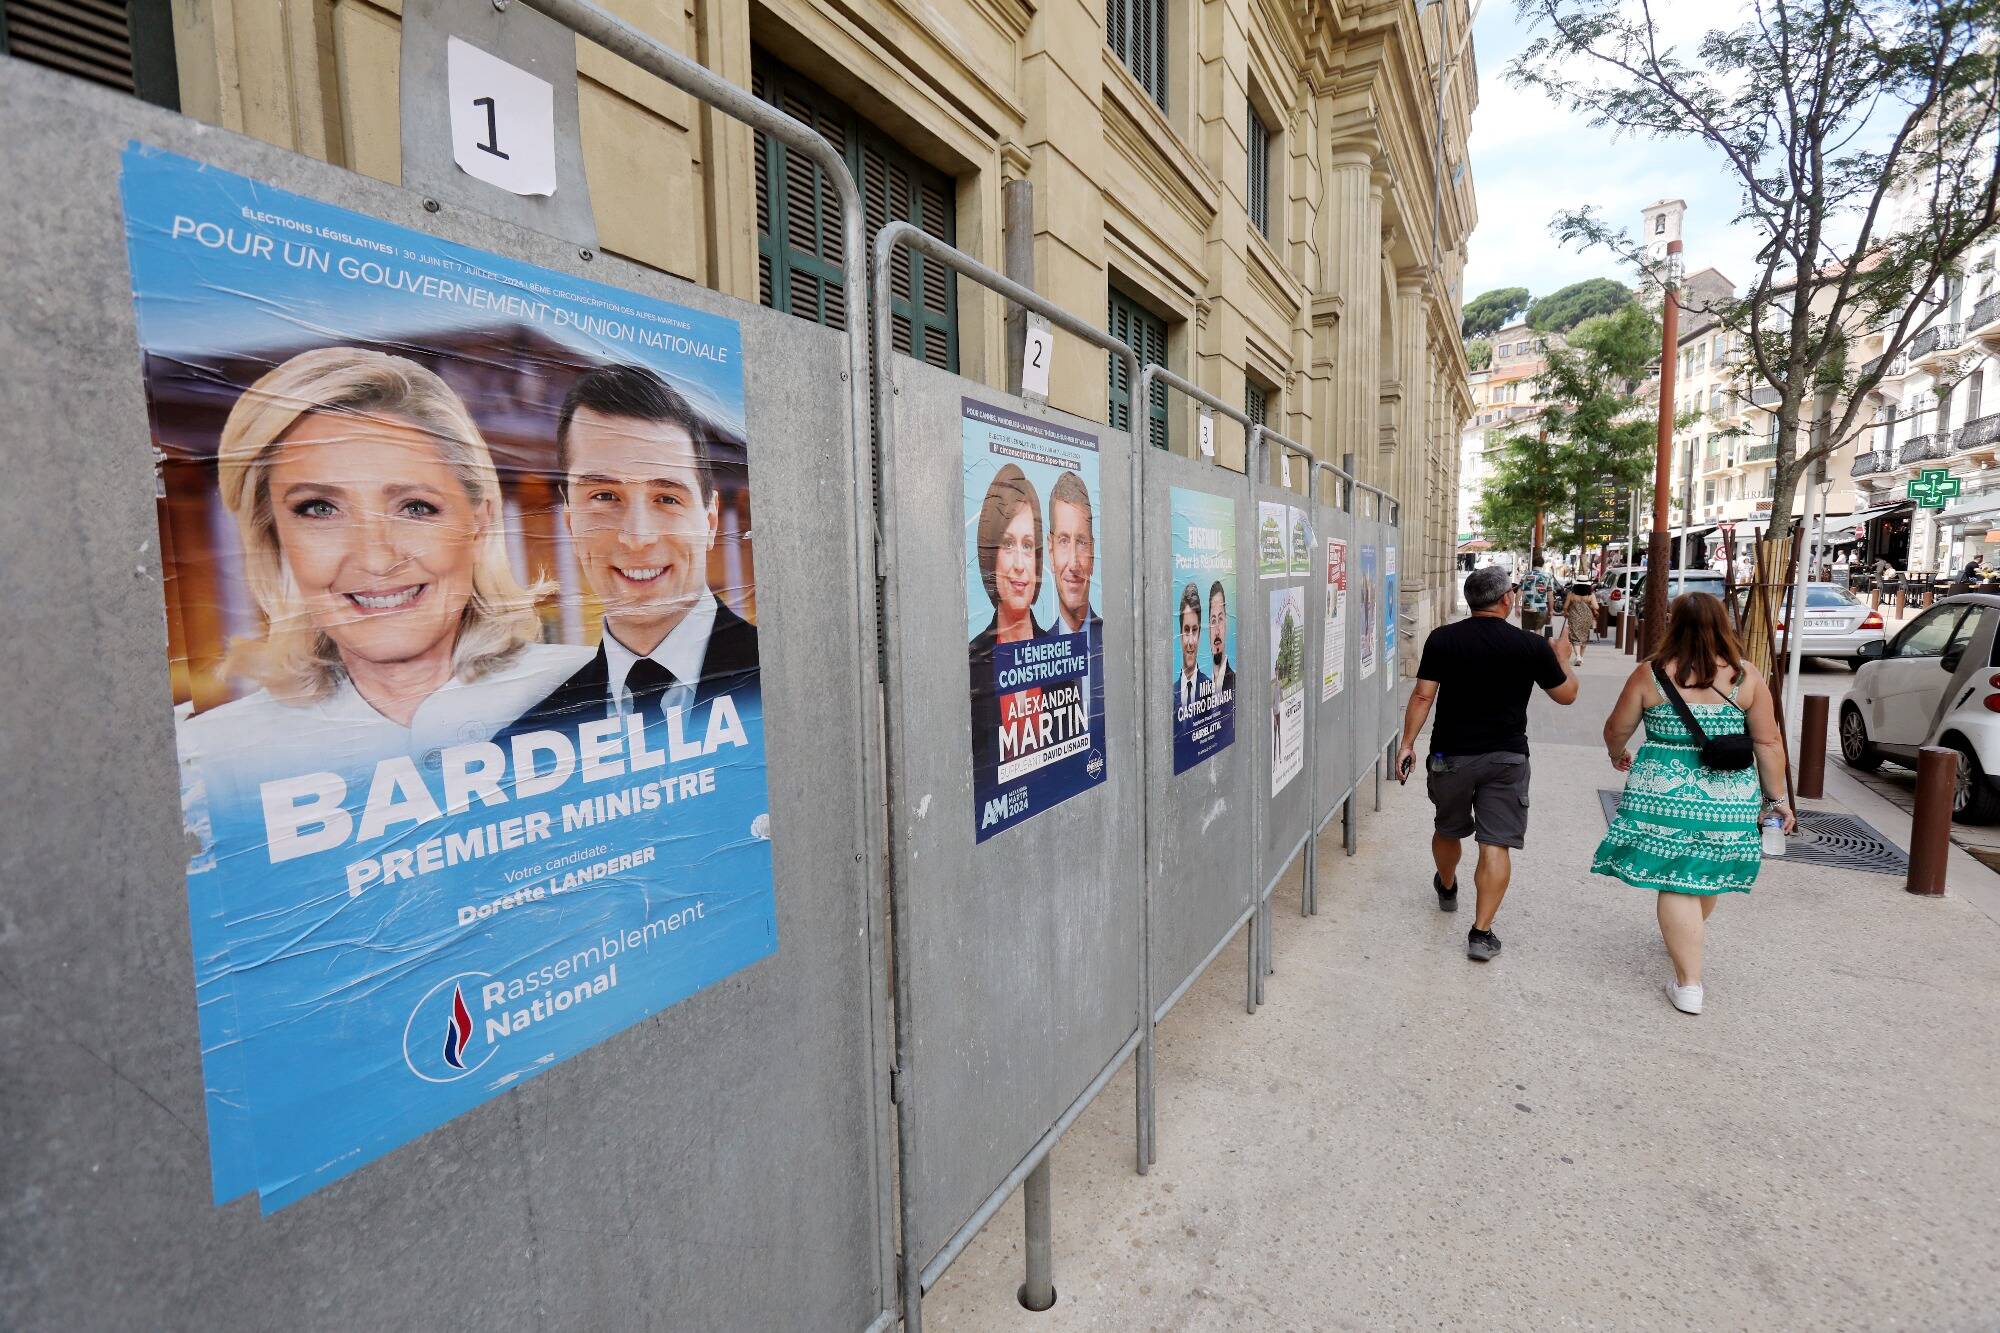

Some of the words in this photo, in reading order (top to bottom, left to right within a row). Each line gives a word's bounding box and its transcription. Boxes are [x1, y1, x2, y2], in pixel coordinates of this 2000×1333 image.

[473, 96, 510, 161] 1
[241, 206, 313, 234] ÉLECTIONS
[315, 226, 393, 255] LÉGISLATIVES
[402, 249, 416, 261] 30
[418, 254, 441, 268] JUIN
[442, 259, 455, 272] ET
[456, 262, 462, 273] 7
[552, 289, 621, 313] CIRCONSCRIPTION
[620, 305, 635, 316] DES
[171, 215, 274, 261] POUR
[283, 241, 330, 273] UN
[338, 256, 551, 321] GOUVERNEMENT
[553, 307, 635, 343] D'UNION
[638, 327, 728, 363] NATIONALE
[1031, 338, 1043, 370] 2
[1202, 424, 1210, 445] 3
[1036, 454, 1045, 463] des
[999, 655, 1085, 689] CONSTRUCTIVE
[1014, 640, 1072, 666] L'ÉNERGIE
[1007, 685, 1081, 721] ALEXANDRA
[1177, 698, 1206, 722] CASTRO
[998, 701, 1089, 763] MARTIN
[1042, 746, 1063, 762] DAVID
[1063, 737, 1089, 757] LISNARD
[259, 694, 749, 864] BARDELLA
[1008, 798, 1029, 817] 2024
[346, 809, 551, 898] PREMIER
[562, 766, 717, 834] MINISTRE
[504, 863, 542, 884] Votre
[545, 844, 608, 871] candidate
[457, 884, 545, 927] Dorette
[550, 846, 656, 895] LANDERER
[482, 900, 705, 1011] Rassemblement
[485, 963, 618, 1045] National
